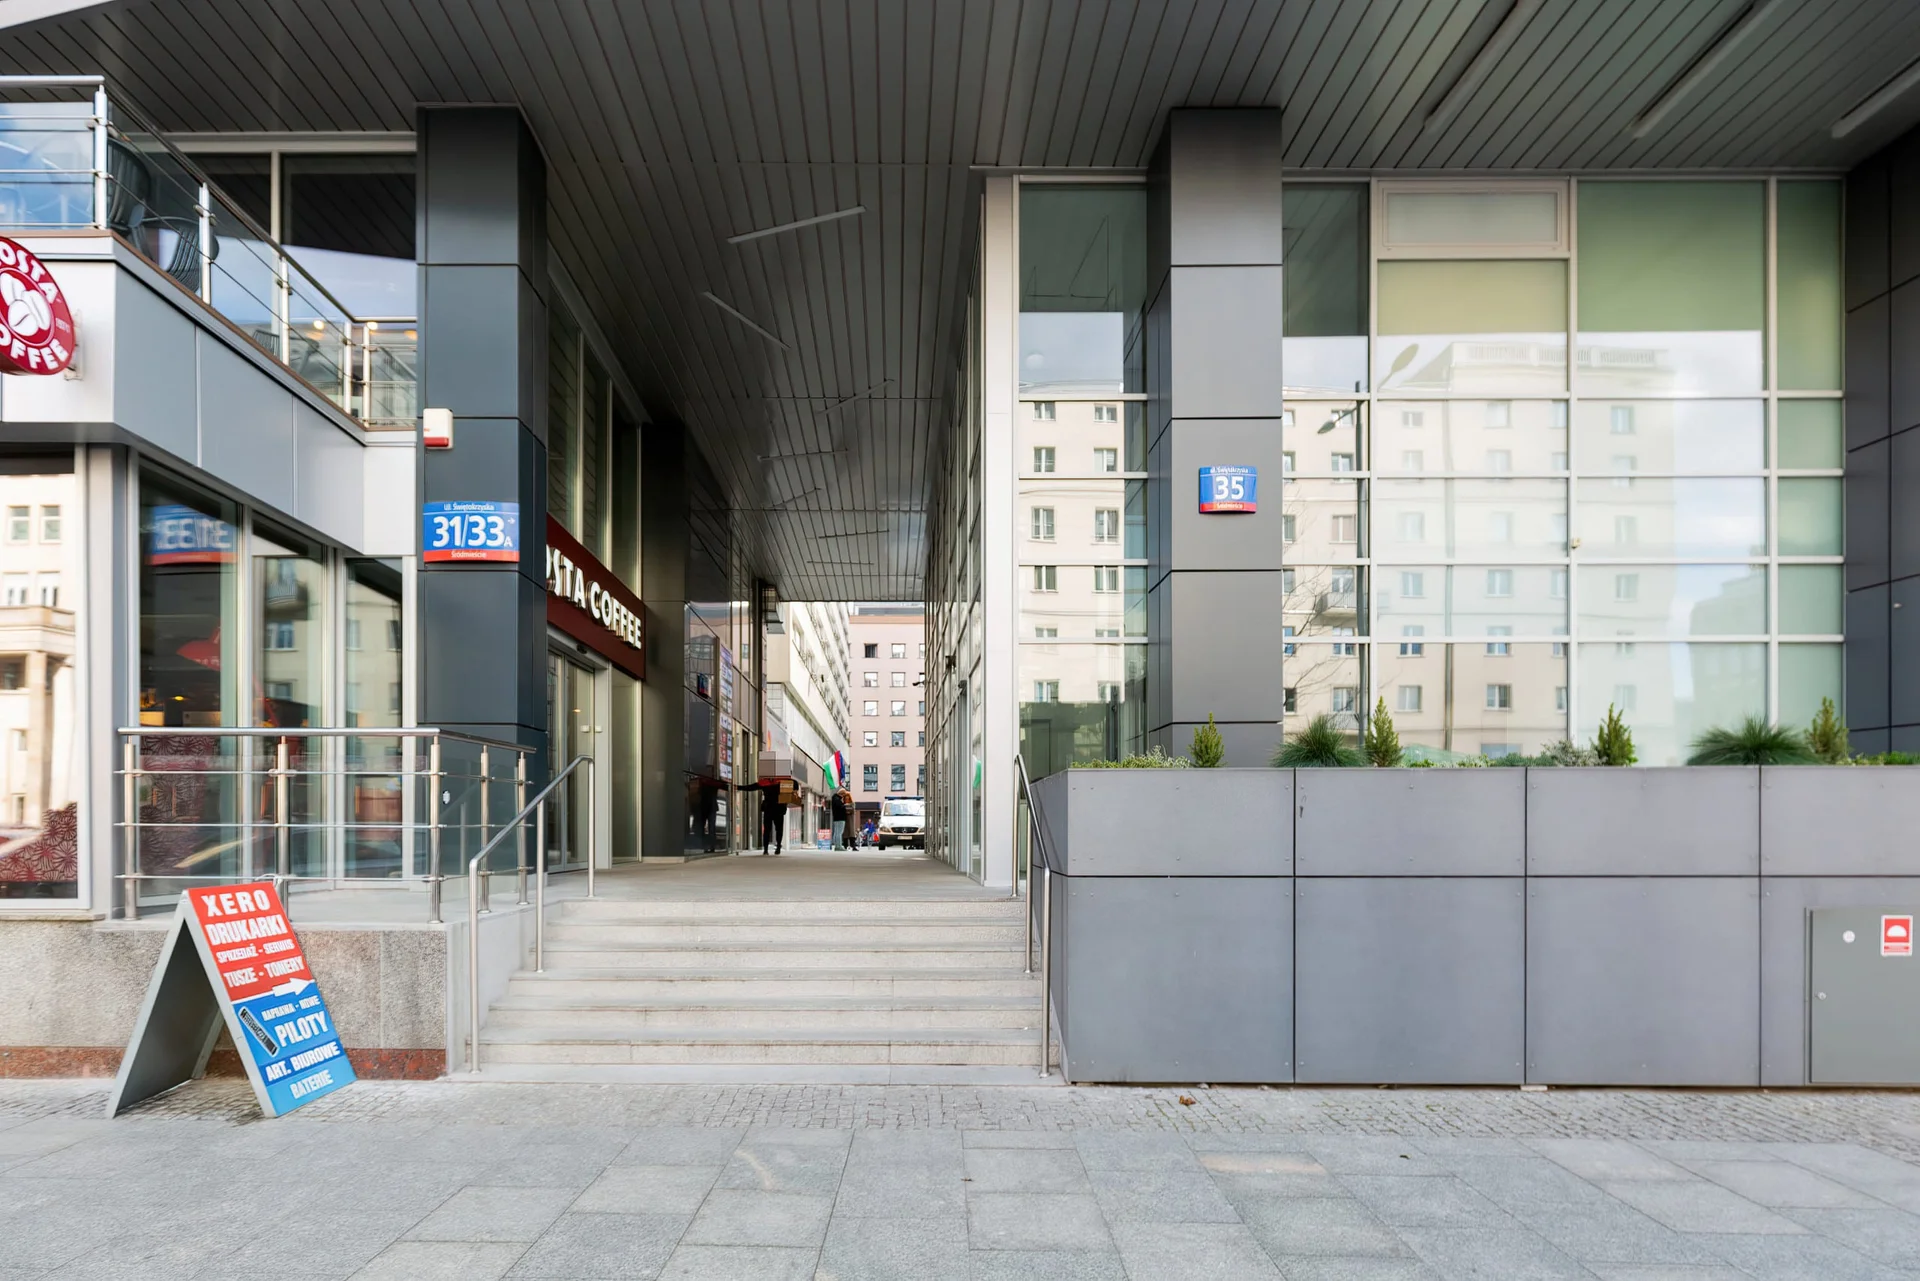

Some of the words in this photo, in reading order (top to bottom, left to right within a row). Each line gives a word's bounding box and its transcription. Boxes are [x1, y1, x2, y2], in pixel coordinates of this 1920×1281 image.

[0, 241, 58, 304] OSTA
[0, 323, 69, 370] OFFEE
[1214, 476, 1244, 500] 35
[546, 544, 586, 609] STA
[589, 581, 642, 650] COFFEE
[201, 889, 271, 917] XERO
[204, 914, 288, 946] DRUKARKI
[223, 967, 259, 988] TUSZE
[264, 955, 305, 978] TONERY
[261, 1003, 296, 1022] NAPRAWA
[274, 1011, 328, 1048] PILOTY
[265, 1060, 292, 1082] ART.
[290, 1041, 340, 1072] BIUROWE
[290, 1069, 333, 1099] BATERIE
